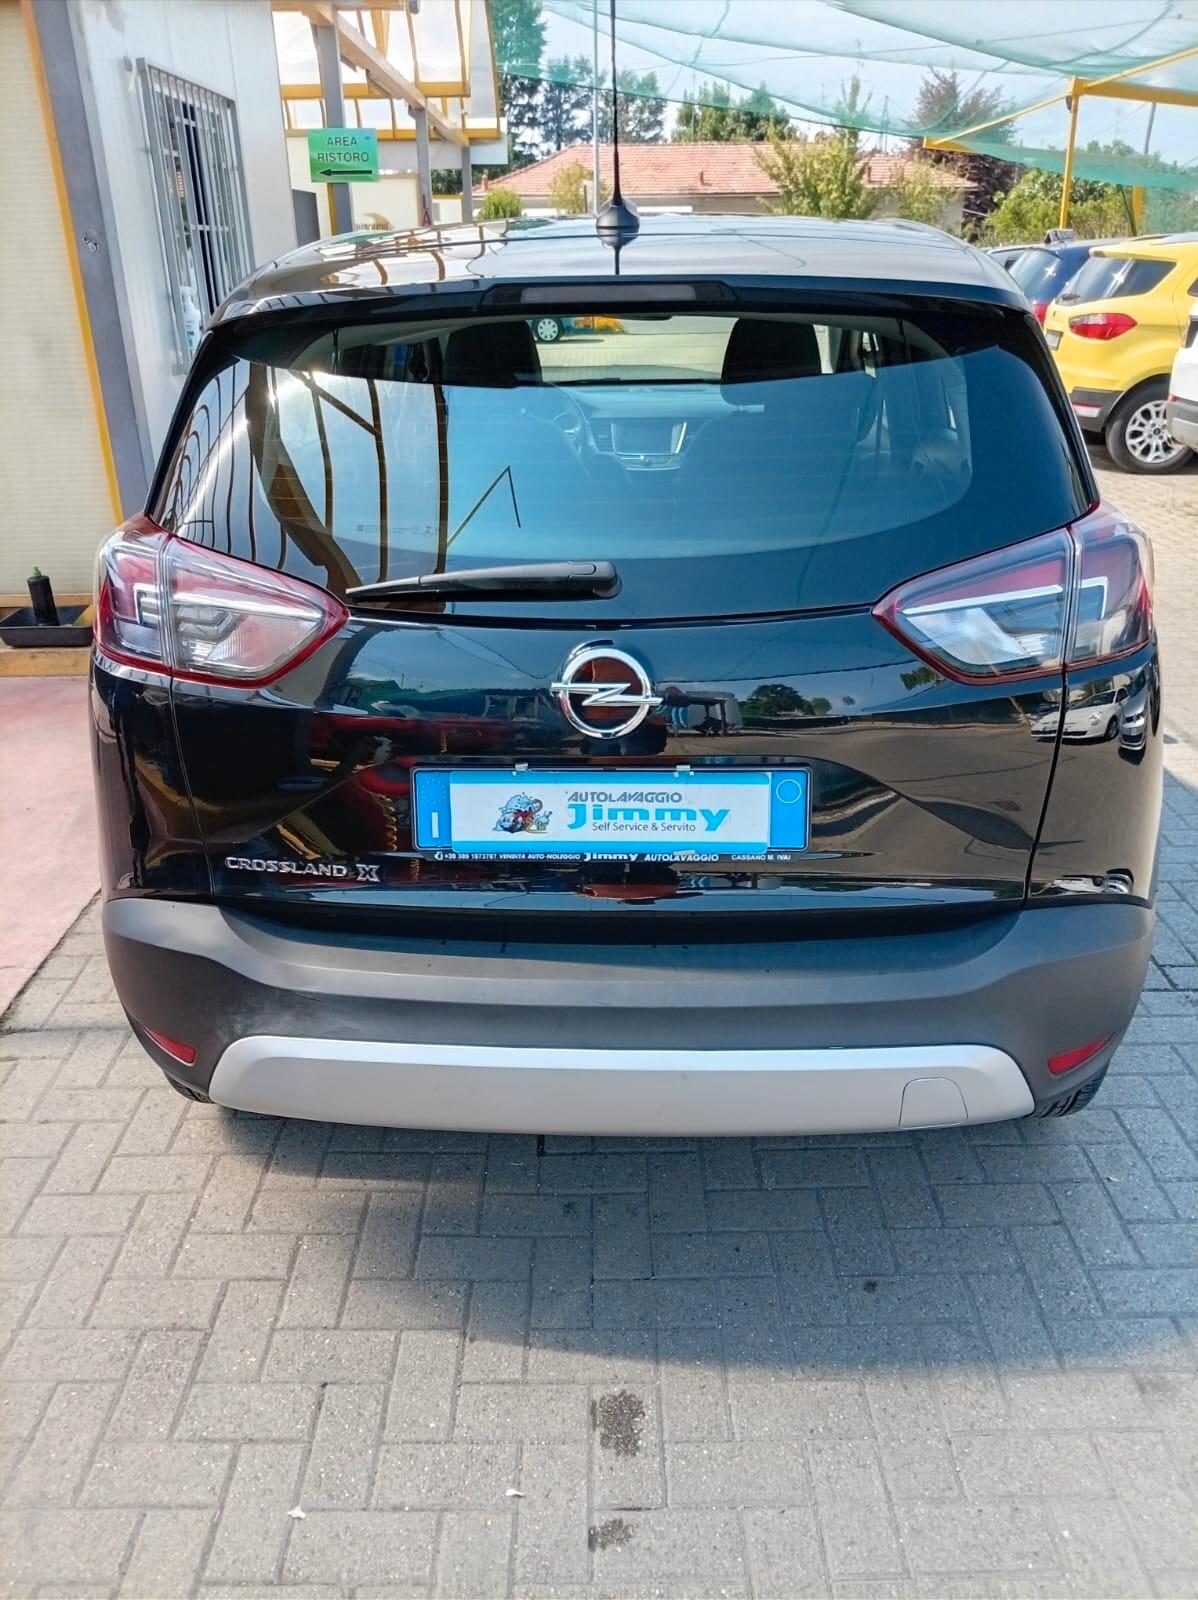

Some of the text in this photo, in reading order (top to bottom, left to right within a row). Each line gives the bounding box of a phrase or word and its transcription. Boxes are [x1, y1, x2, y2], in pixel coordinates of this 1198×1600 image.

[327, 136, 357, 147] AREA
[317, 152, 369, 162] RISTORO
[568, 791, 683, 803] AUTOLAVAGGIO
[567, 803, 730, 832] Jimmy
[592, 822, 696, 832] Self Service & Servito
[583, 851, 639, 862] Jimmy
[644, 853, 719, 862] AUTOLAVAGGIO
[225, 856, 381, 883] CROSSLAND X
